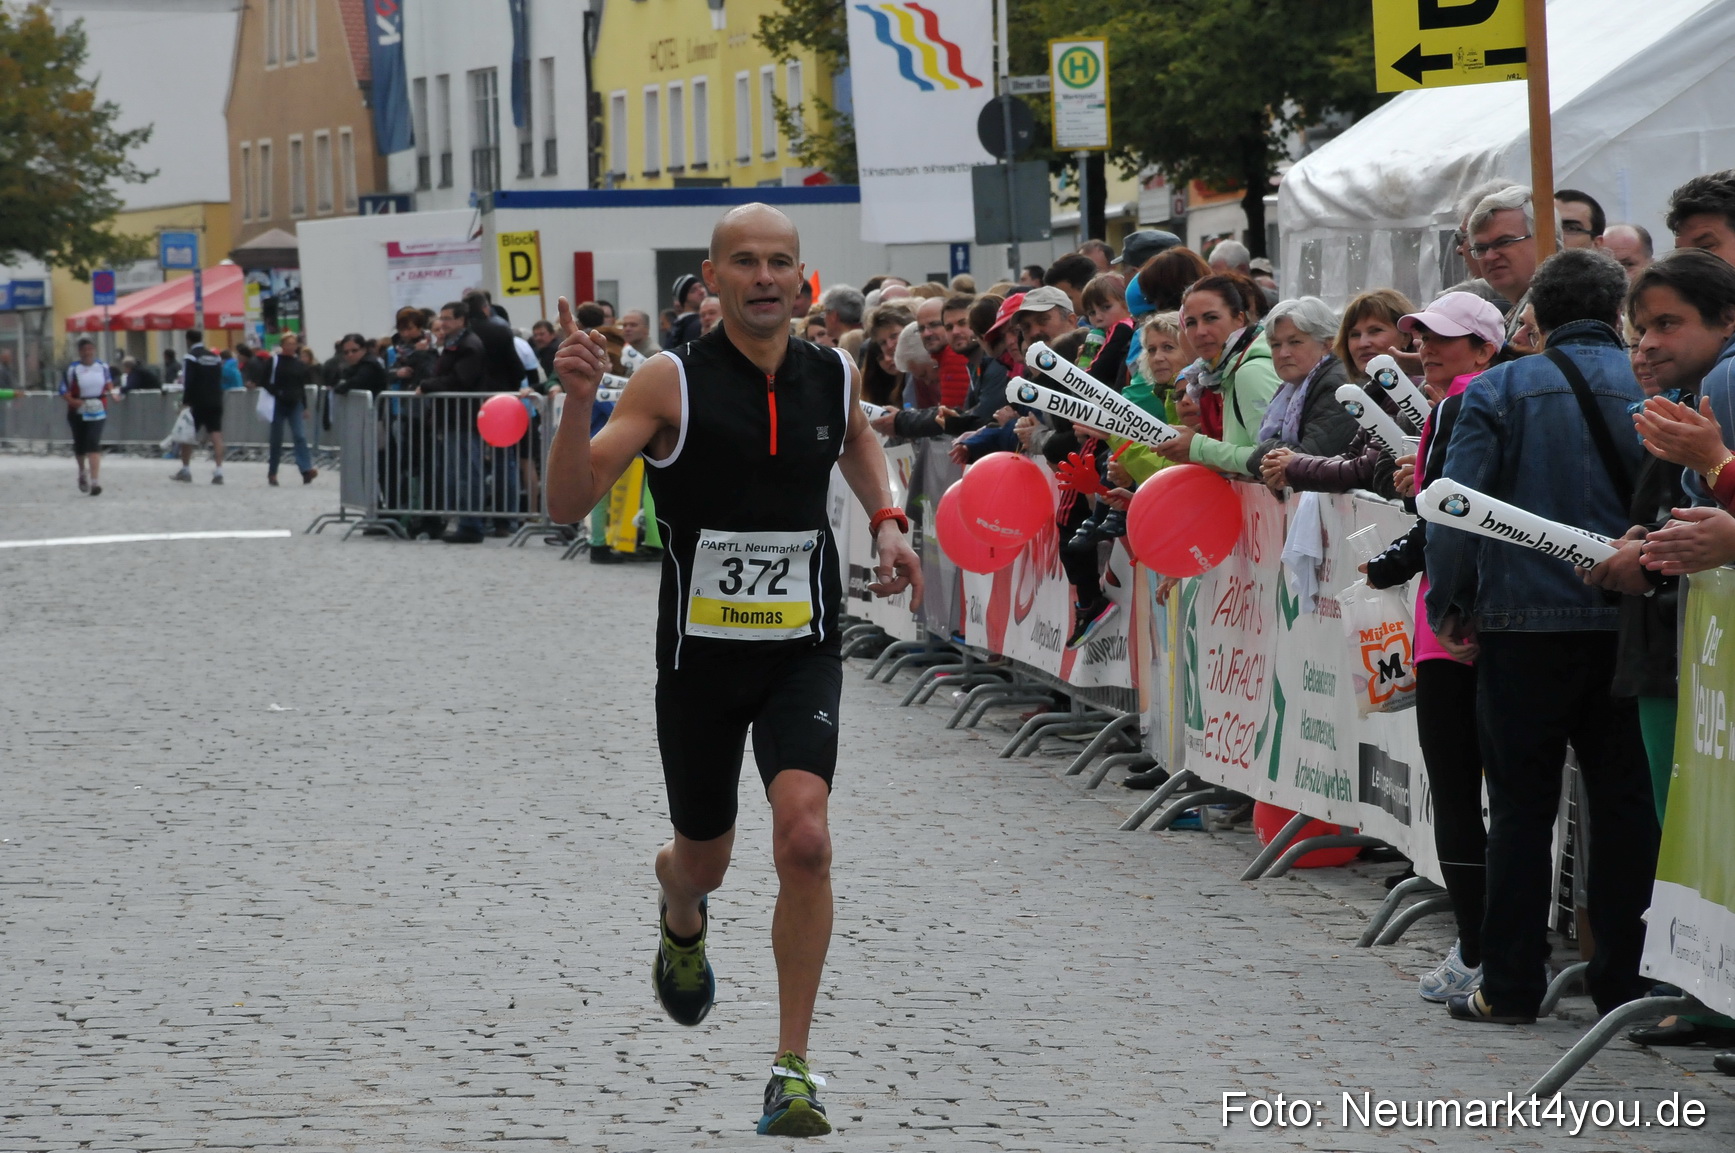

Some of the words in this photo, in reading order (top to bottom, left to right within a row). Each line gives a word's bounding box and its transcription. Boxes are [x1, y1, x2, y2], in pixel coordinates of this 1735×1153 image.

[1069, 56, 1089, 79] H
[502, 234, 535, 247] Block
[510, 251, 532, 282] D
[1047, 393, 1094, 422] BMW
[700, 539, 742, 553] PARTL
[745, 542, 800, 554] Neumarkt
[719, 556, 790, 596] 372
[721, 606, 783, 625] Thomas
[1359, 621, 1404, 643] Müler
[1702, 615, 1724, 667] Der
[1377, 652, 1406, 684] M
